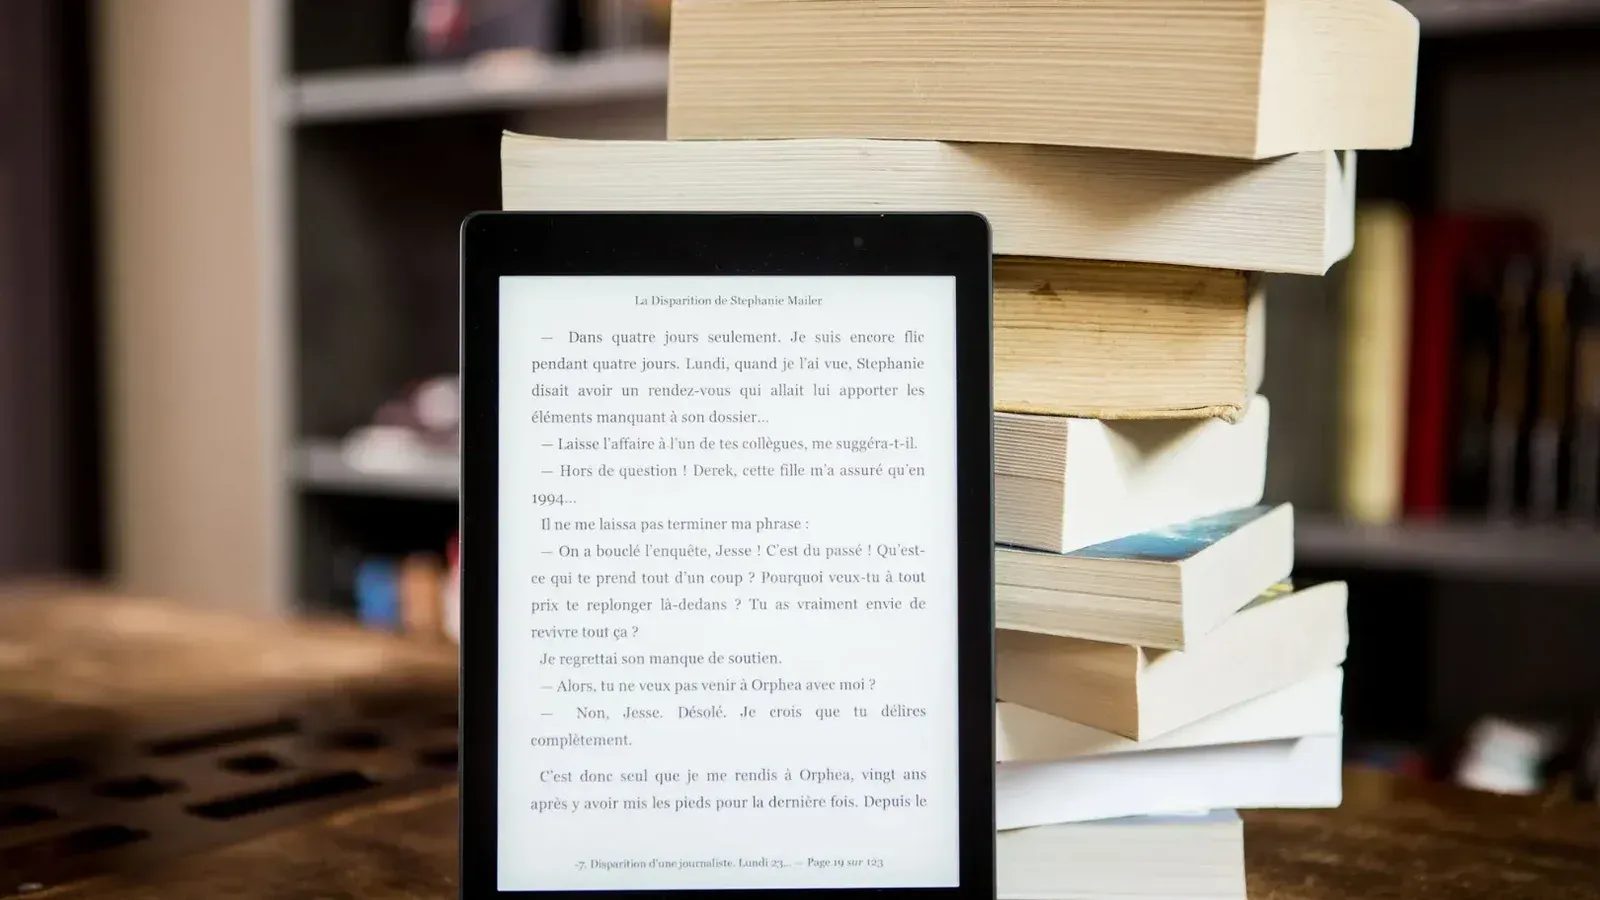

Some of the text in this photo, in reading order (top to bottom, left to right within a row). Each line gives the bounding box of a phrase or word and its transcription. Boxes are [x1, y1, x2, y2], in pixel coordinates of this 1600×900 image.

[635, 295, 822, 308] La Disparition de Stephanie Mailer
[569, 330, 924, 347] Dans quatre jours seulement. Je suis encore flic
[532, 355, 924, 373] pendant quatre jours. Lundi, quand je l'ai vue, Stephanie
[532, 382, 925, 400] disait avoir un rendez-vous qui allait lui apporter les
[532, 410, 593, 426] éléments
[596, 412, 668, 428] manquant
[669, 410, 679, 426] à
[681, 413, 705, 424] son
[558, 436, 917, 453] Laisse l'affaire à l'un de tes collègues, me suggéra-t-il.
[560, 461, 925, 479] Hors de question Derek, cette fille m'a assuré qu'en
[542, 517, 801, 533] Il ne me laissa pas terminer ma phrase
[559, 542, 925, 560] On a bouclé l'enquête, Jesse C'est du passé Qu'est-
[531, 570, 925, 588] ce qui te prend tout d'un coup Pourquoi veux-tu à tout
[532, 597, 926, 614] prix te replonger là-dedans Tu as vraiment envie de
[531, 624, 628, 641] revivre tout ça
[540, 651, 782, 668] Je regrettai son manque de soutien.
[601, 681, 614, 692] tu
[618, 682, 637, 692] ne
[639, 681, 671, 692] veux
[674, 682, 699, 695] pas
[701, 679, 736, 691] venir
[740, 678, 748, 691] à
[752, 678, 802, 694] Orphea
[805, 682, 835, 691] avec
[840, 678, 864, 690] moi
[576, 704, 926, 720] Non, Jesse. Désolé. Je crois que tu délires
[531, 733, 632, 750] complètement.
[540, 768, 926, 786] C'est donc seul que je me rendis à Orphea, vingt ans
[531, 793, 927, 813] après y avoir mis les pieds pour la dernière fois. Depuis le
